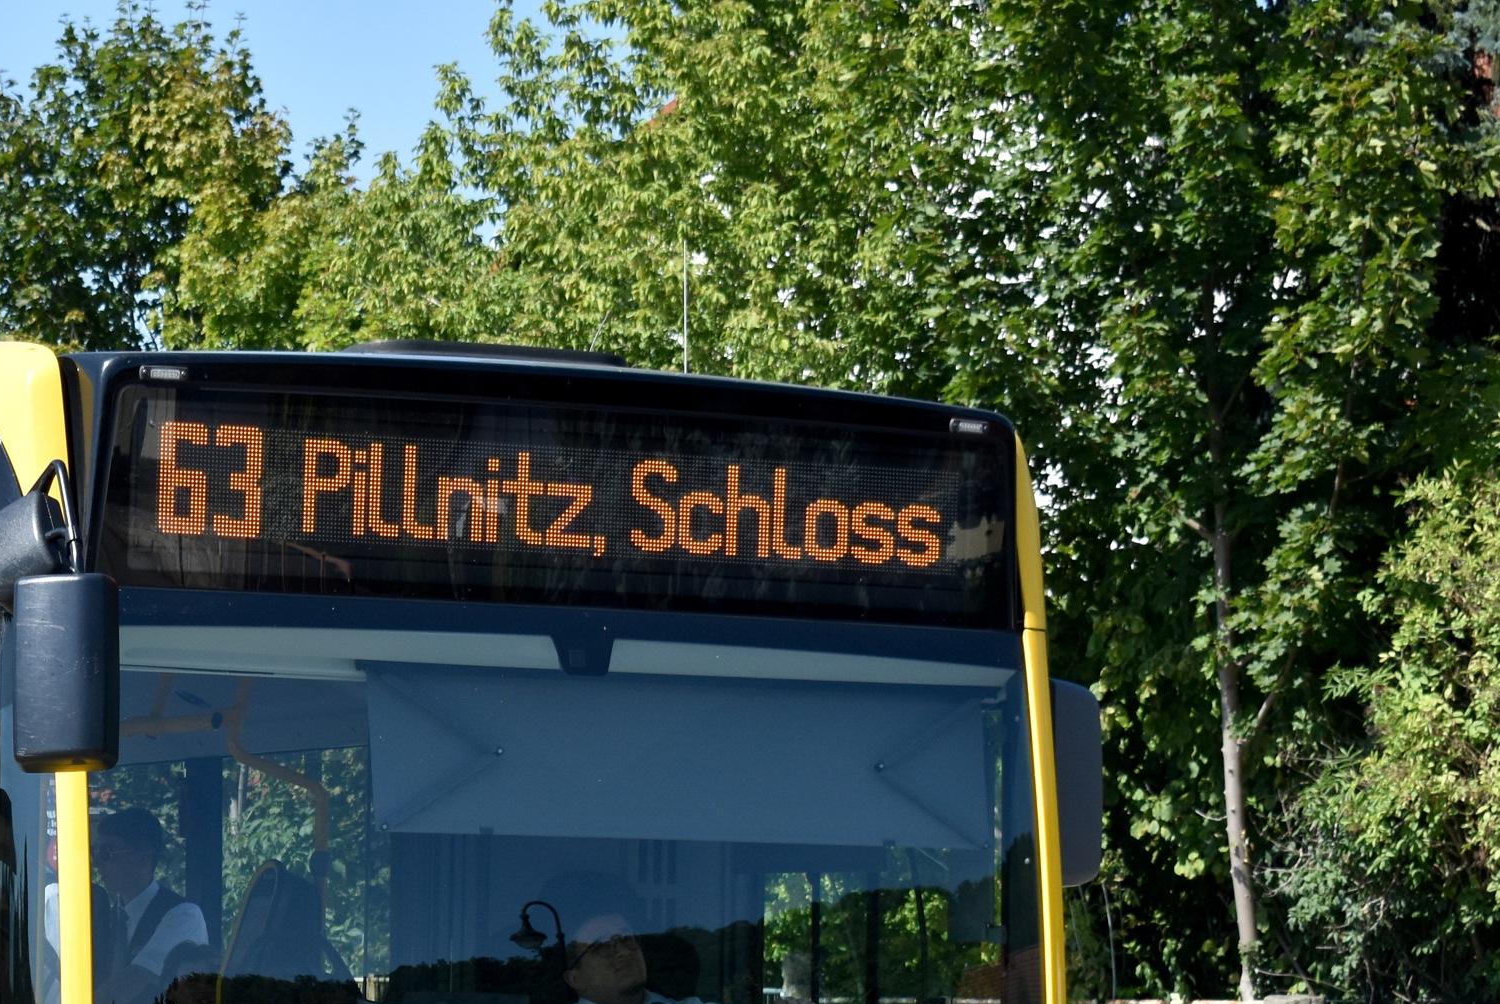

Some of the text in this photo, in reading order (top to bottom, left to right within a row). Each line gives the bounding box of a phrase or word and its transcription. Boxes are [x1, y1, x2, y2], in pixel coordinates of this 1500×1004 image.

[158, 421, 941, 567] 63 Pillnitz, Schloss
